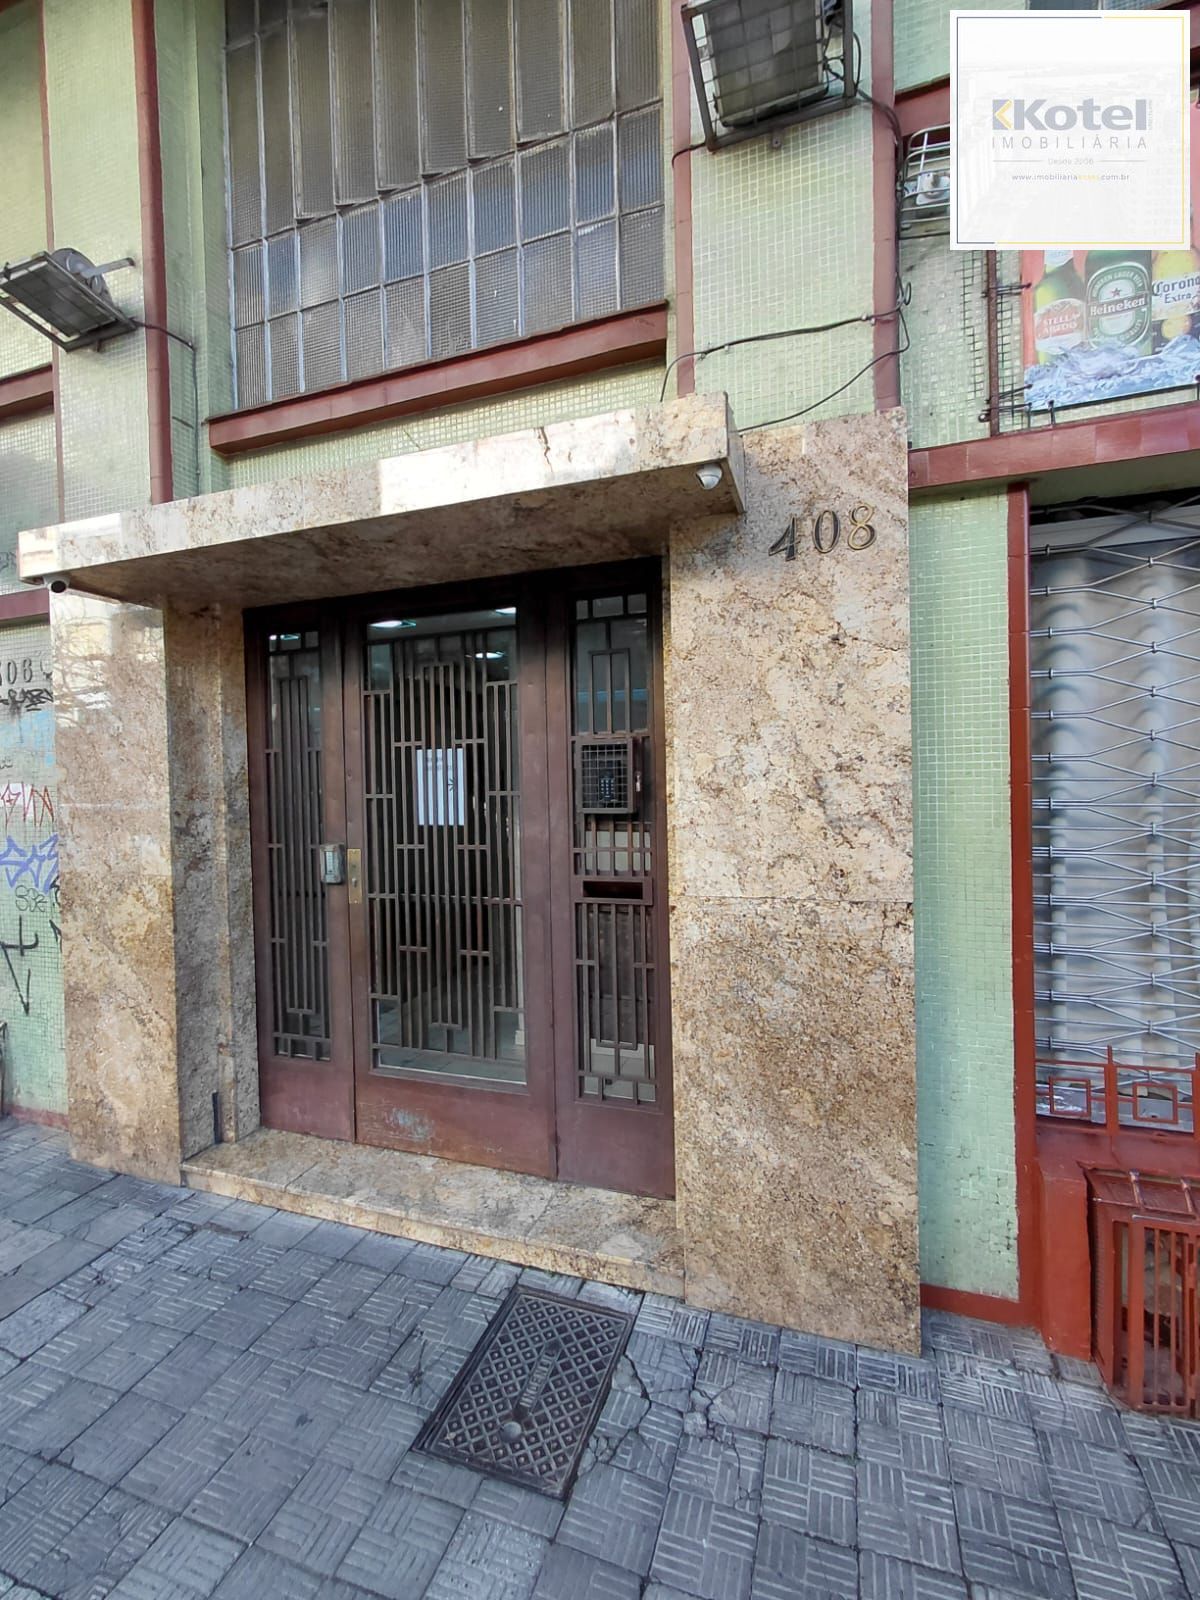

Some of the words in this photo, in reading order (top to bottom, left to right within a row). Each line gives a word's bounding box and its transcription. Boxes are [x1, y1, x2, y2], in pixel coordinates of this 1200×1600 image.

[1089, 297, 1147, 316] Heineken
[1164, 292, 1192, 304] Extra
[767, 501, 878, 562] 408
[0, 656, 33, 686] 08
